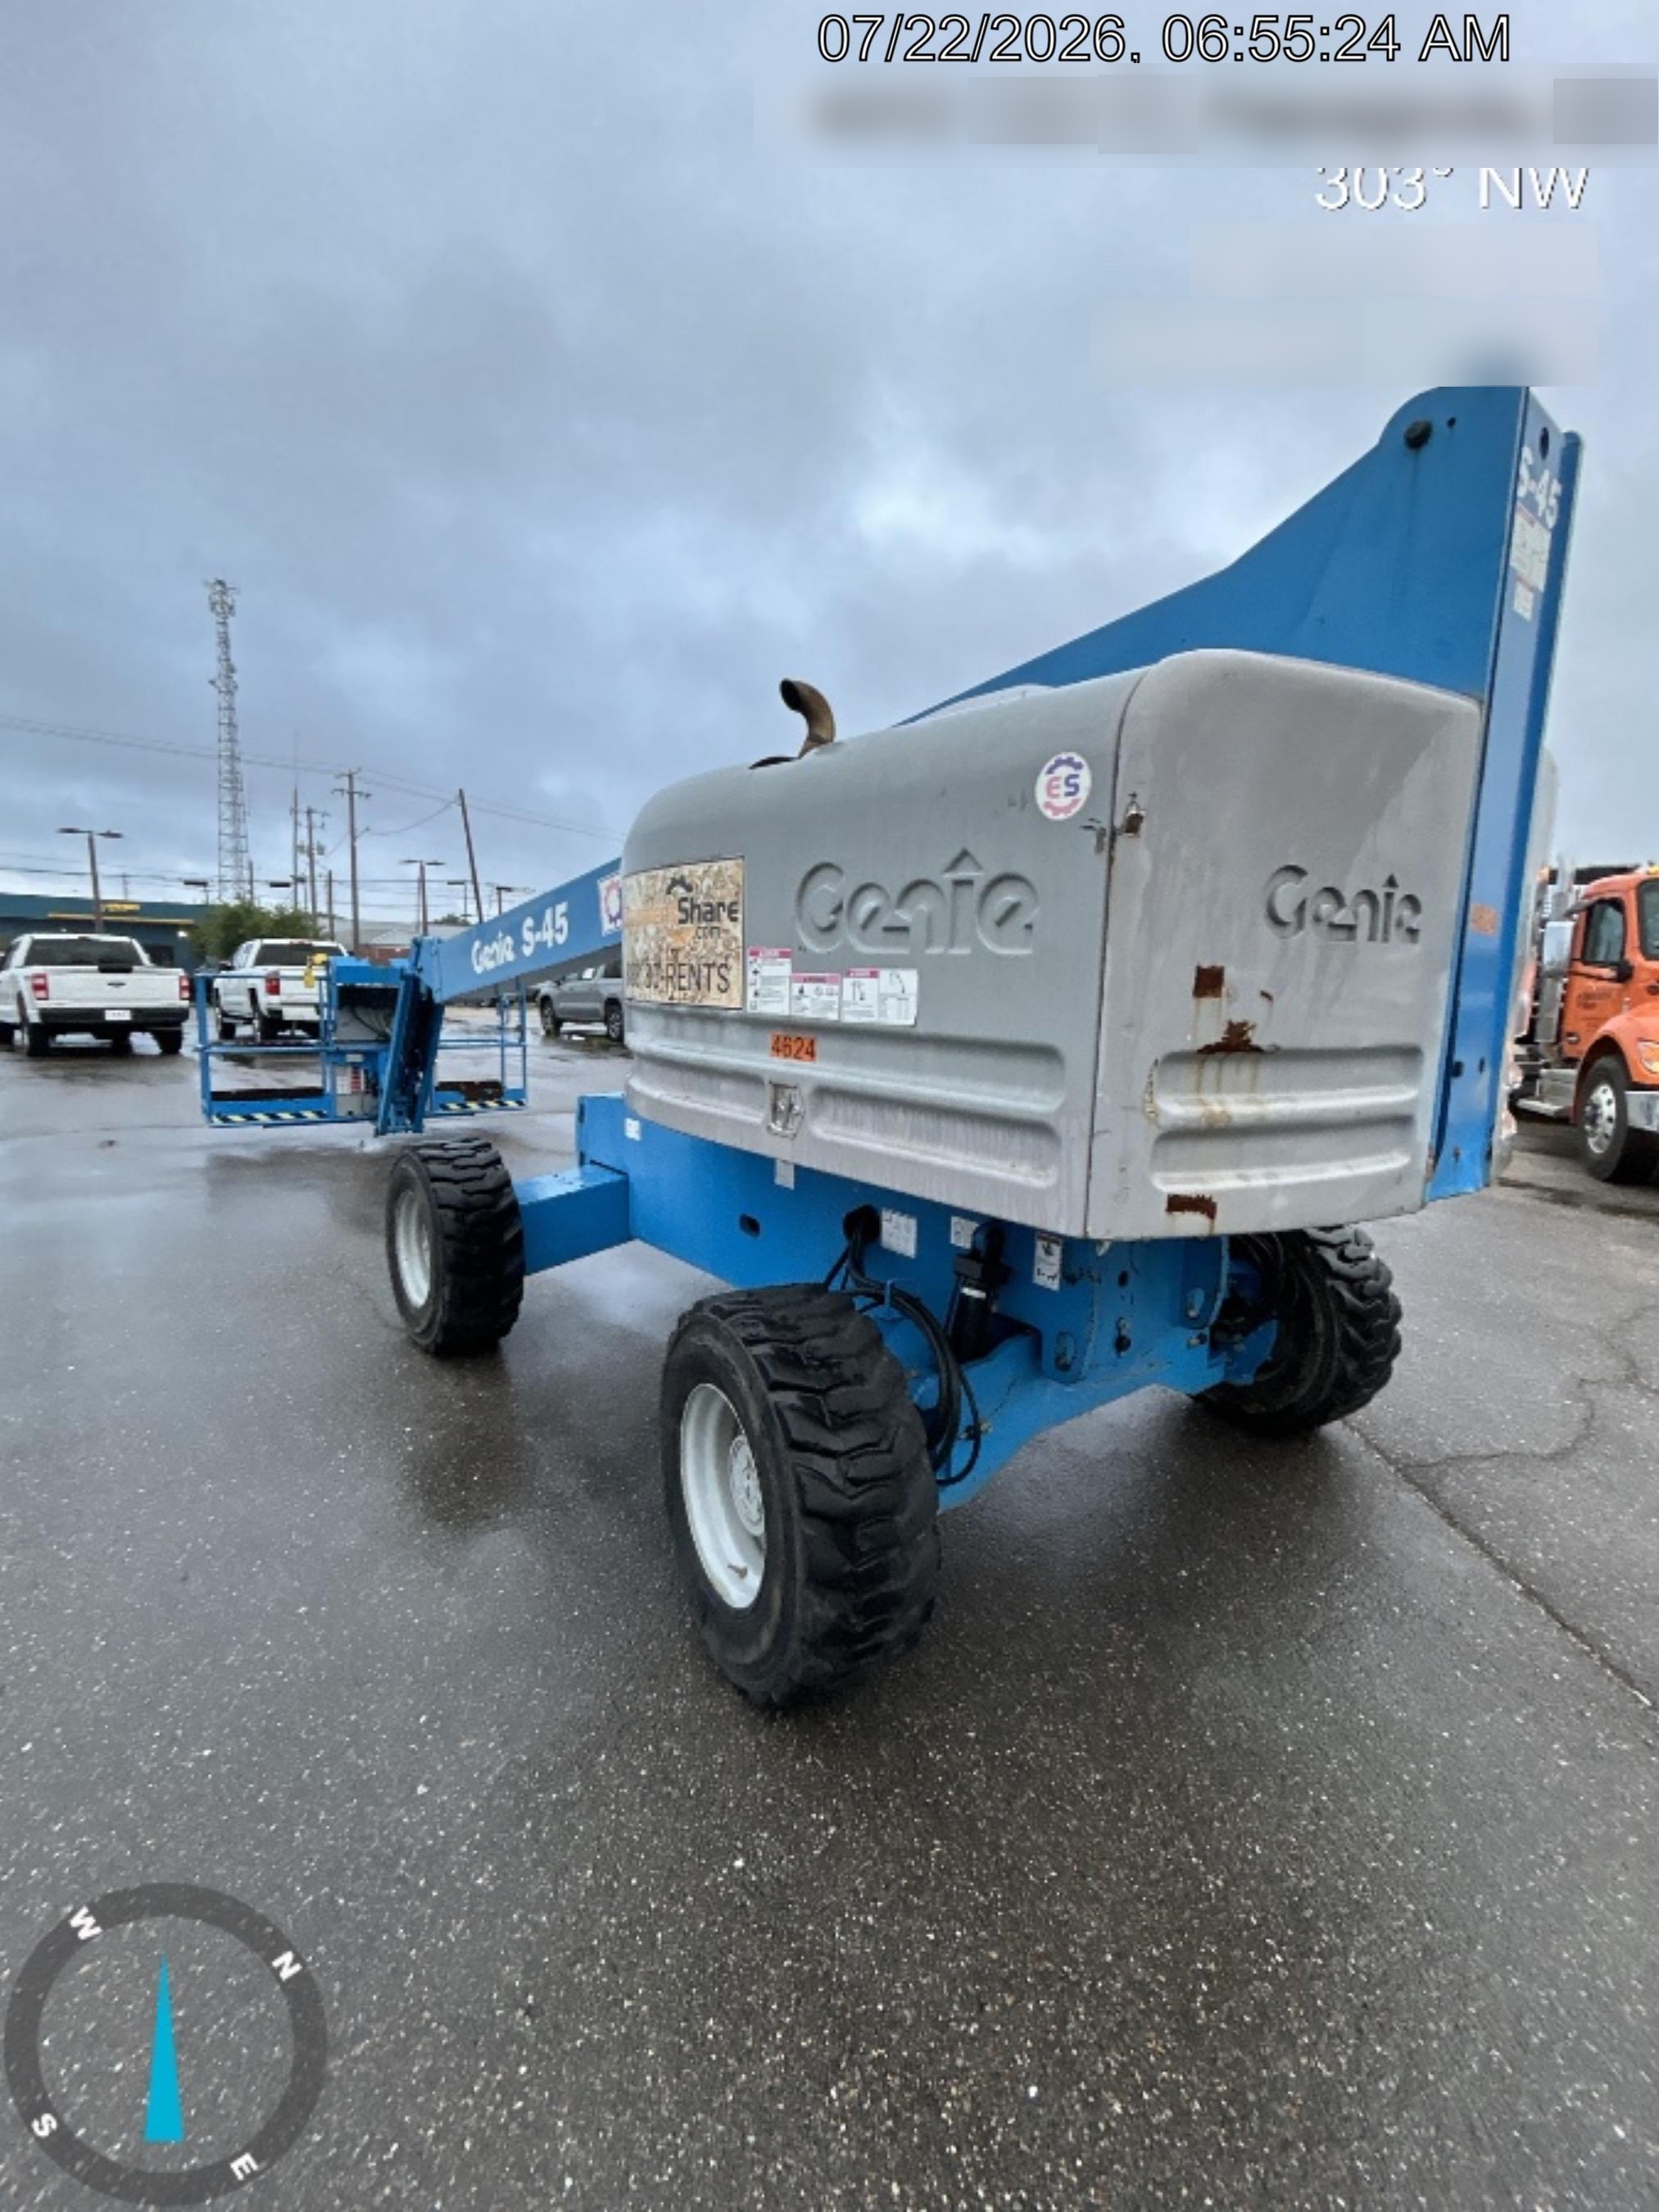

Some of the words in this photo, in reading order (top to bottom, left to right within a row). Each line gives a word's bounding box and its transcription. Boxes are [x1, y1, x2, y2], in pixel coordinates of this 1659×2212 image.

[1516, 446, 1562, 531] S-45
[1046, 773, 1080, 799] ES
[678, 897, 739, 925] Share
[796, 847, 1040, 954] Genie
[1265, 864, 1423, 945] Genie
[521, 901, 569, 958] S-45
[771, 1035, 814, 1060] 4624
